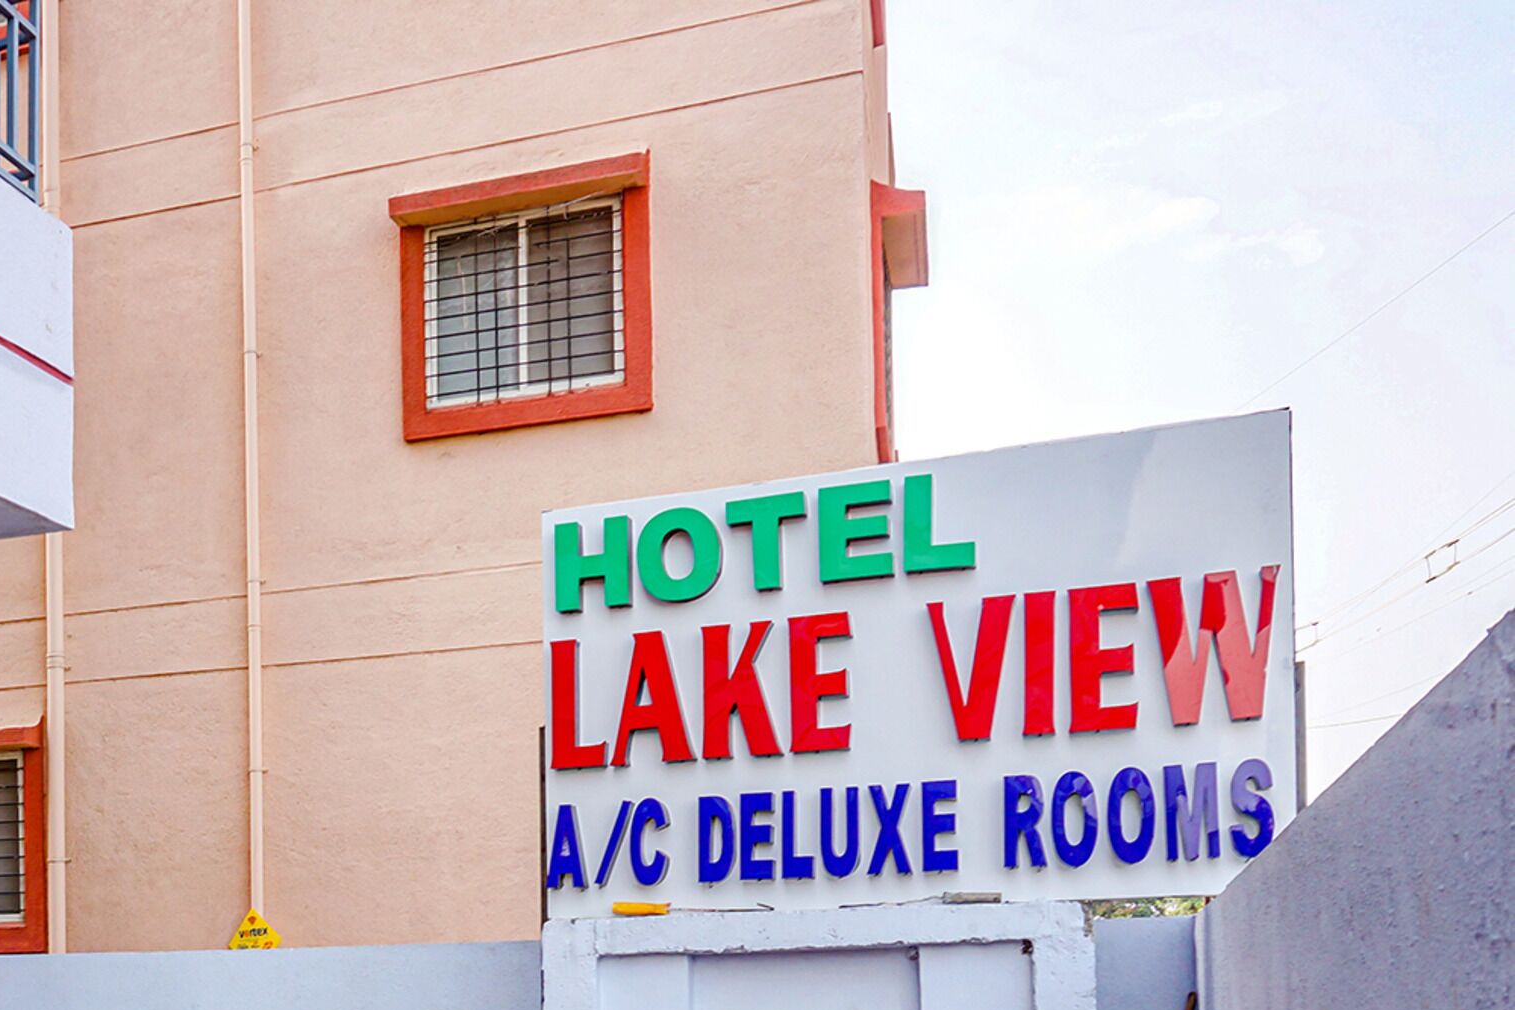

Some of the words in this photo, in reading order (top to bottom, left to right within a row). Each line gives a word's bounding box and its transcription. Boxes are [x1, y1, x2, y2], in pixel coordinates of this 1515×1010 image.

[554, 473, 977, 614] HOTEL
[550, 611, 854, 770] LAKE
[926, 564, 1281, 742] VIEW
[546, 797, 670, 890] A/C
[697, 779, 958, 884] DELUXE
[1003, 757, 1274, 870] ROOMS
